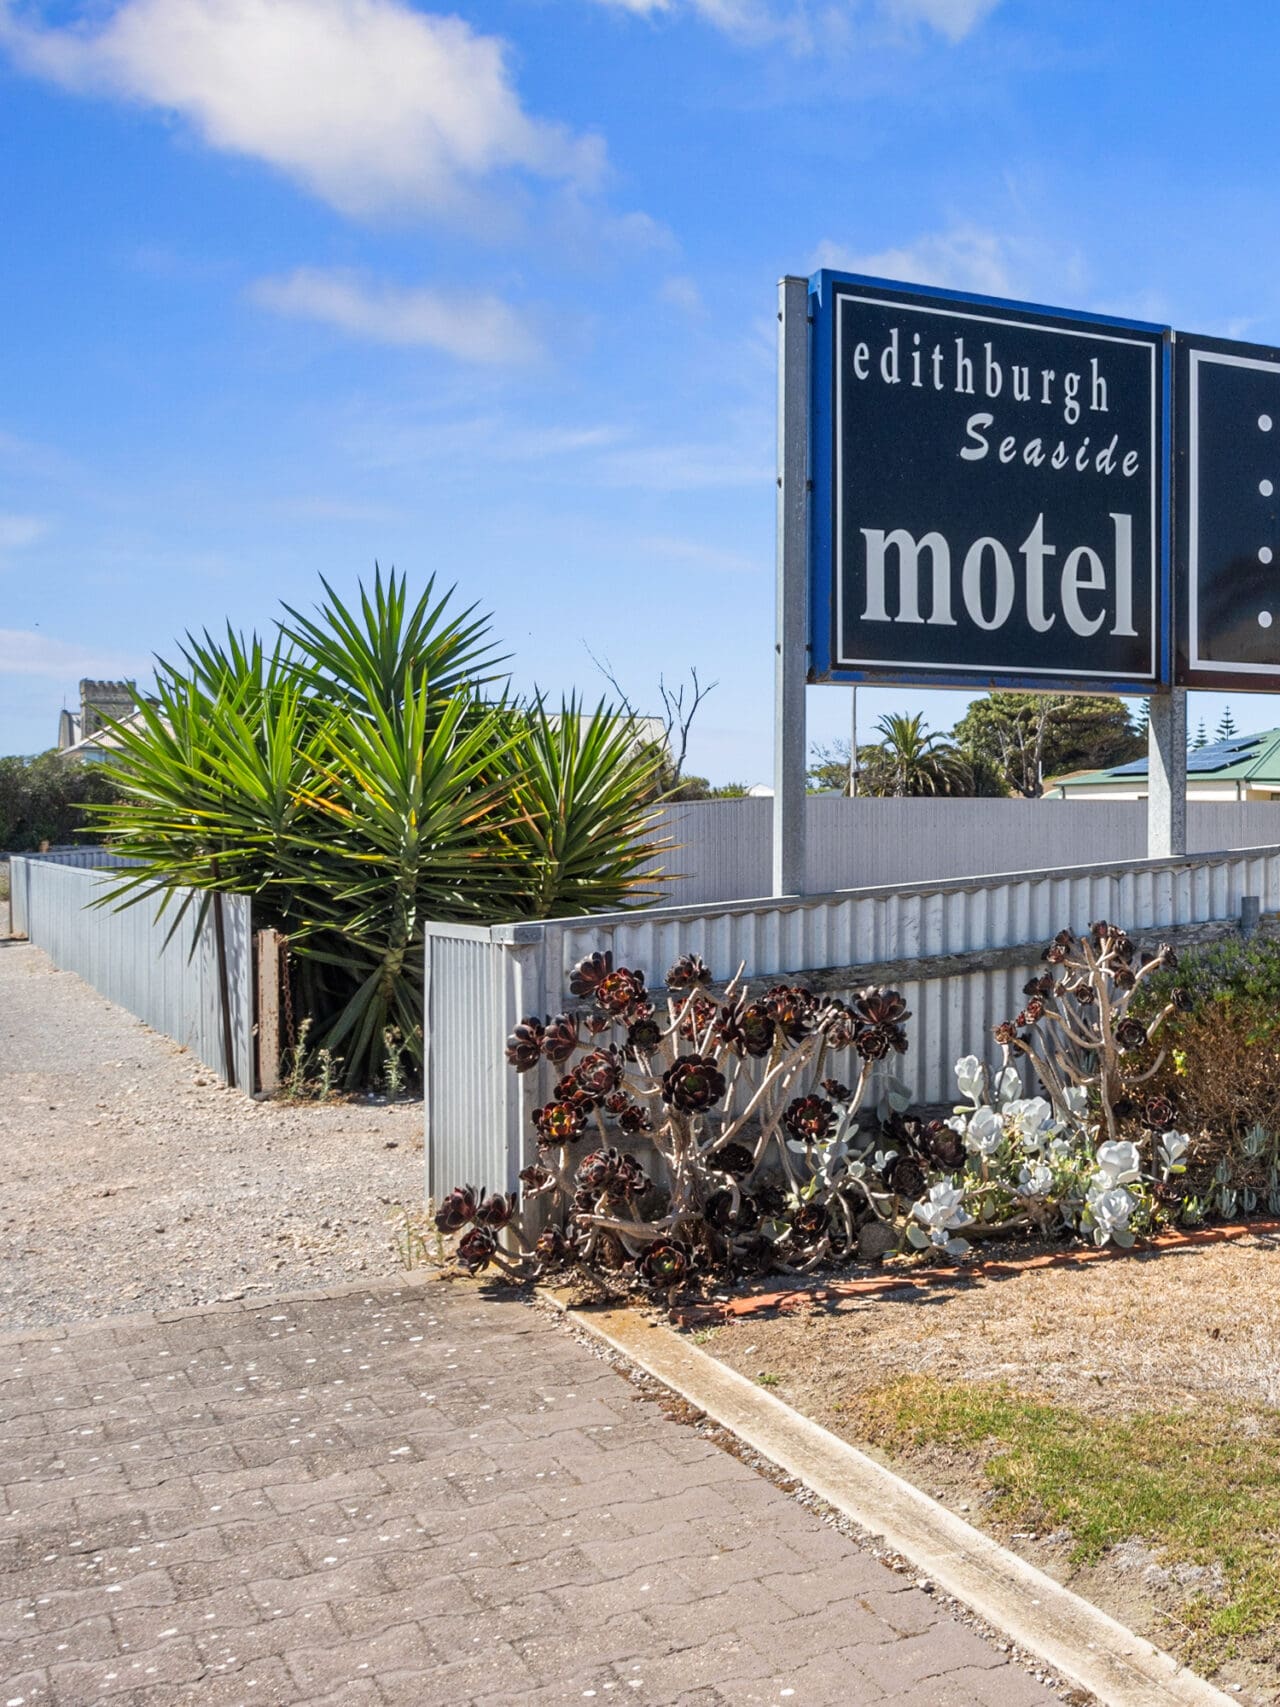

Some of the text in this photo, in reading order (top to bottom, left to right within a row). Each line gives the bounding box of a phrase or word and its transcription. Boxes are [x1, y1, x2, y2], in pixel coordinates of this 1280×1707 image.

[853, 328, 1109, 425] edithburgh
[960, 412, 1139, 477] Seaside
[859, 512, 1138, 637] motel
